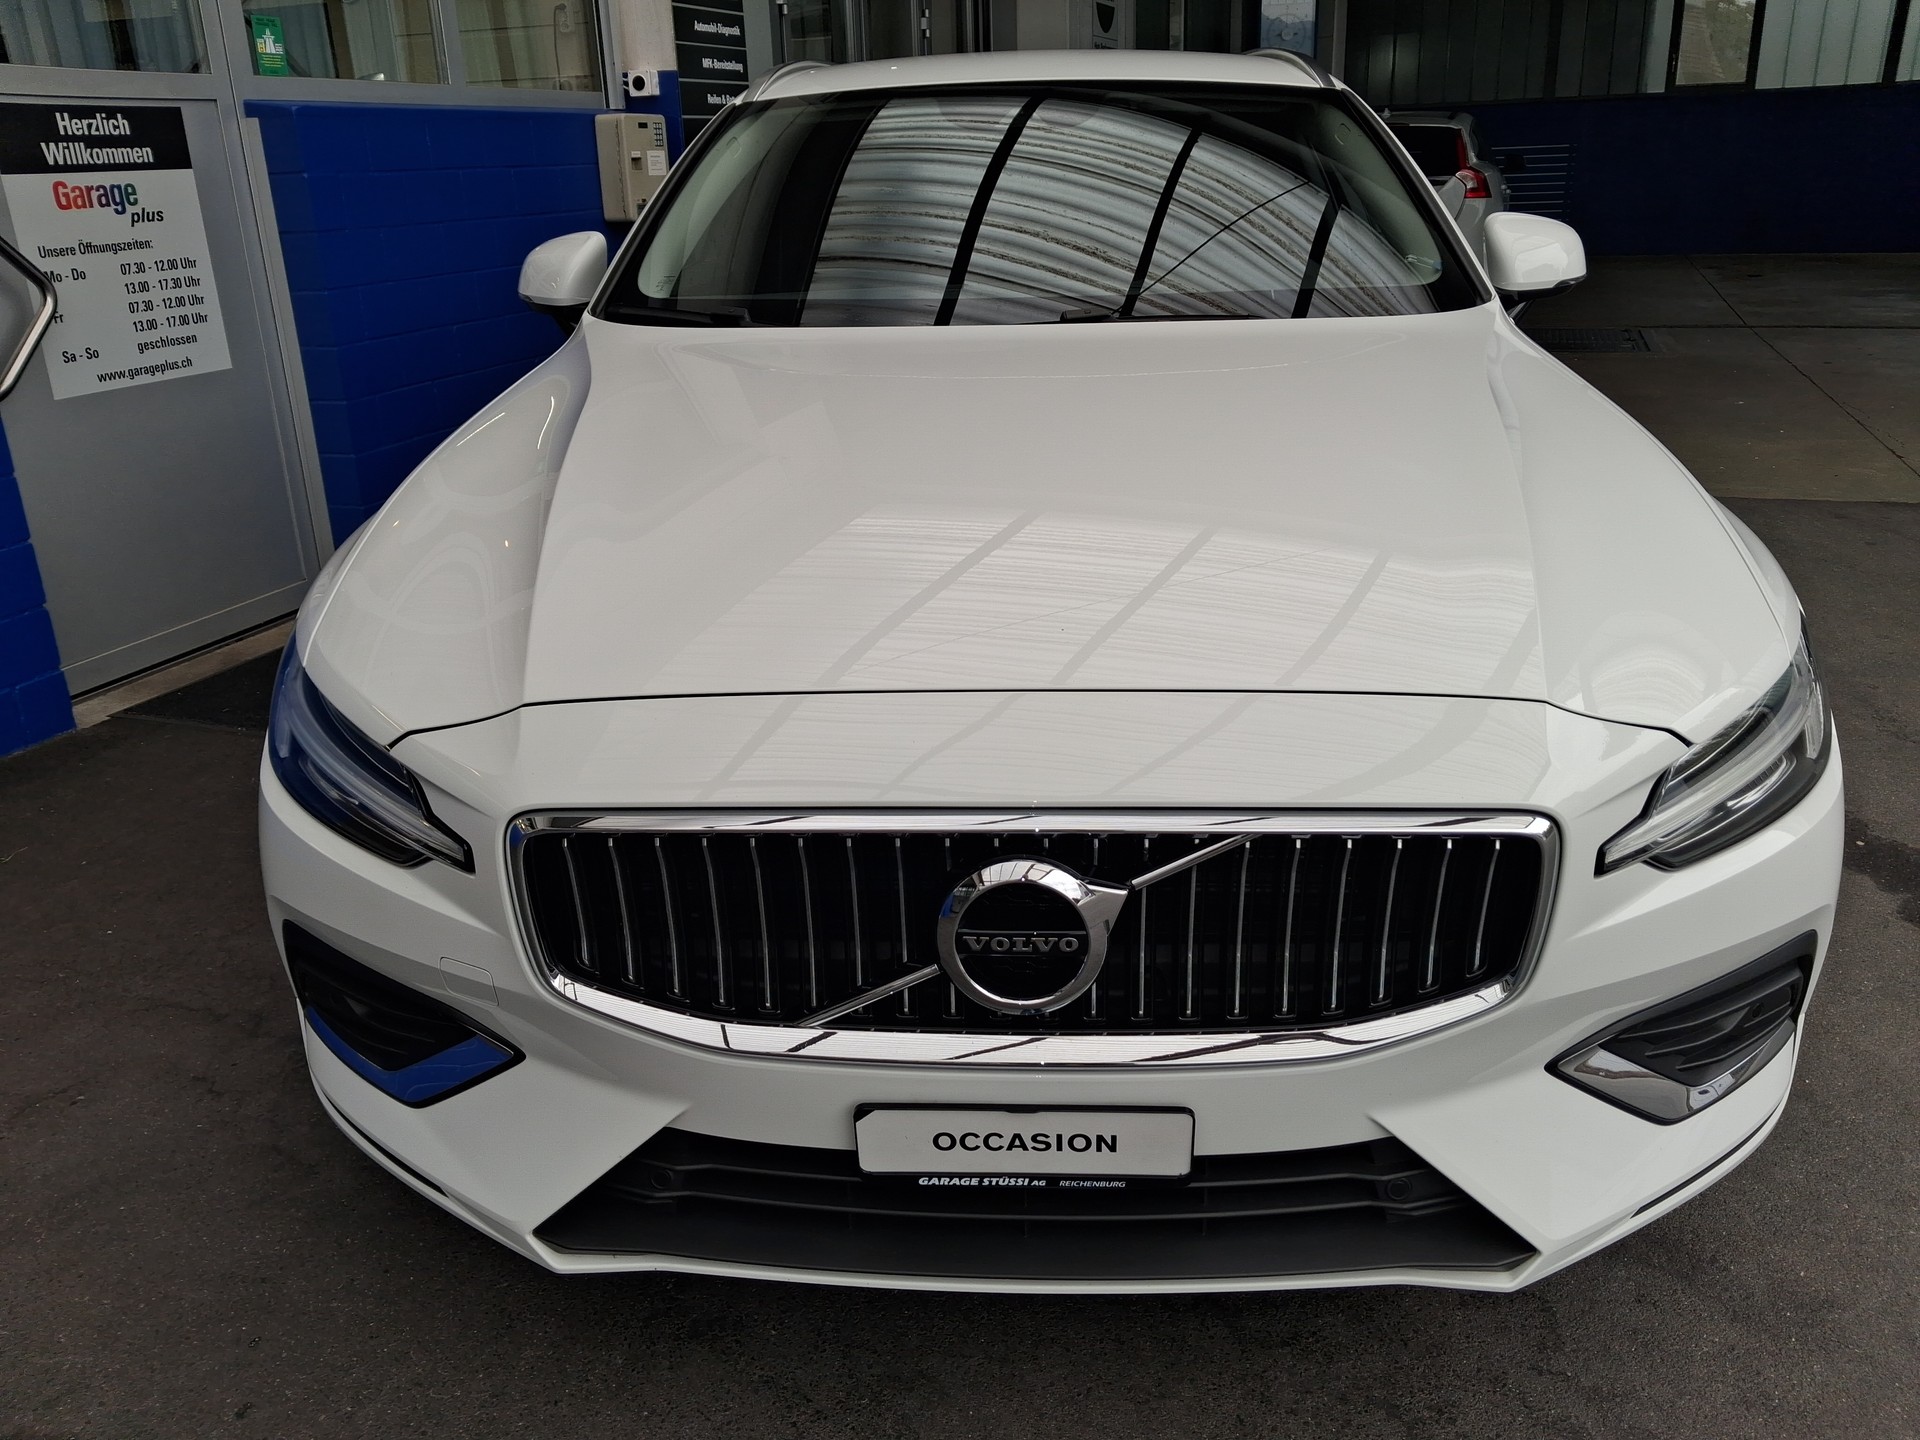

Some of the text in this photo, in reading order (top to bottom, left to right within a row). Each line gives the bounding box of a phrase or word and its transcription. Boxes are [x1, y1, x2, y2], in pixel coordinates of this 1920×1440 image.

[55, 112, 130, 135] Herzlich
[40, 142, 154, 165] Willkommen
[52, 180, 139, 215] Garage
[131, 207, 164, 227] plus
[37, 239, 153, 259] Unsere Öffnungszeiten:
[71, 268, 86, 281] Do
[120, 261, 146, 275] 07.30
[154, 258, 178, 272] 12.00
[179, 257, 197, 269] Uhr
[124, 281, 150, 295] 13.00
[158, 277, 182, 291] 17.30
[184, 275, 201, 288] Uhr
[128, 300, 154, 314] 07.30
[162, 296, 186, 310] 12.00
[187, 294, 204, 306] Uhr
[132, 318, 158, 333] 13.00
[166, 314, 190, 328] 17.00
[191, 312, 208, 325] Uhr
[62, 350, 77, 363] Sa
[85, 347, 99, 360] So
[137, 334, 198, 354] geschlossen
[97, 356, 193, 383] www.garageplus.ch
[963, 936, 1079, 952] VOLVO
[932, 1132, 1118, 1153] OCCASION
[918, 1177, 980, 1186] GARAGE
[982, 1176, 1029, 1186] STÜSSI
[1059, 1180, 1126, 1188] REICHENBURG
